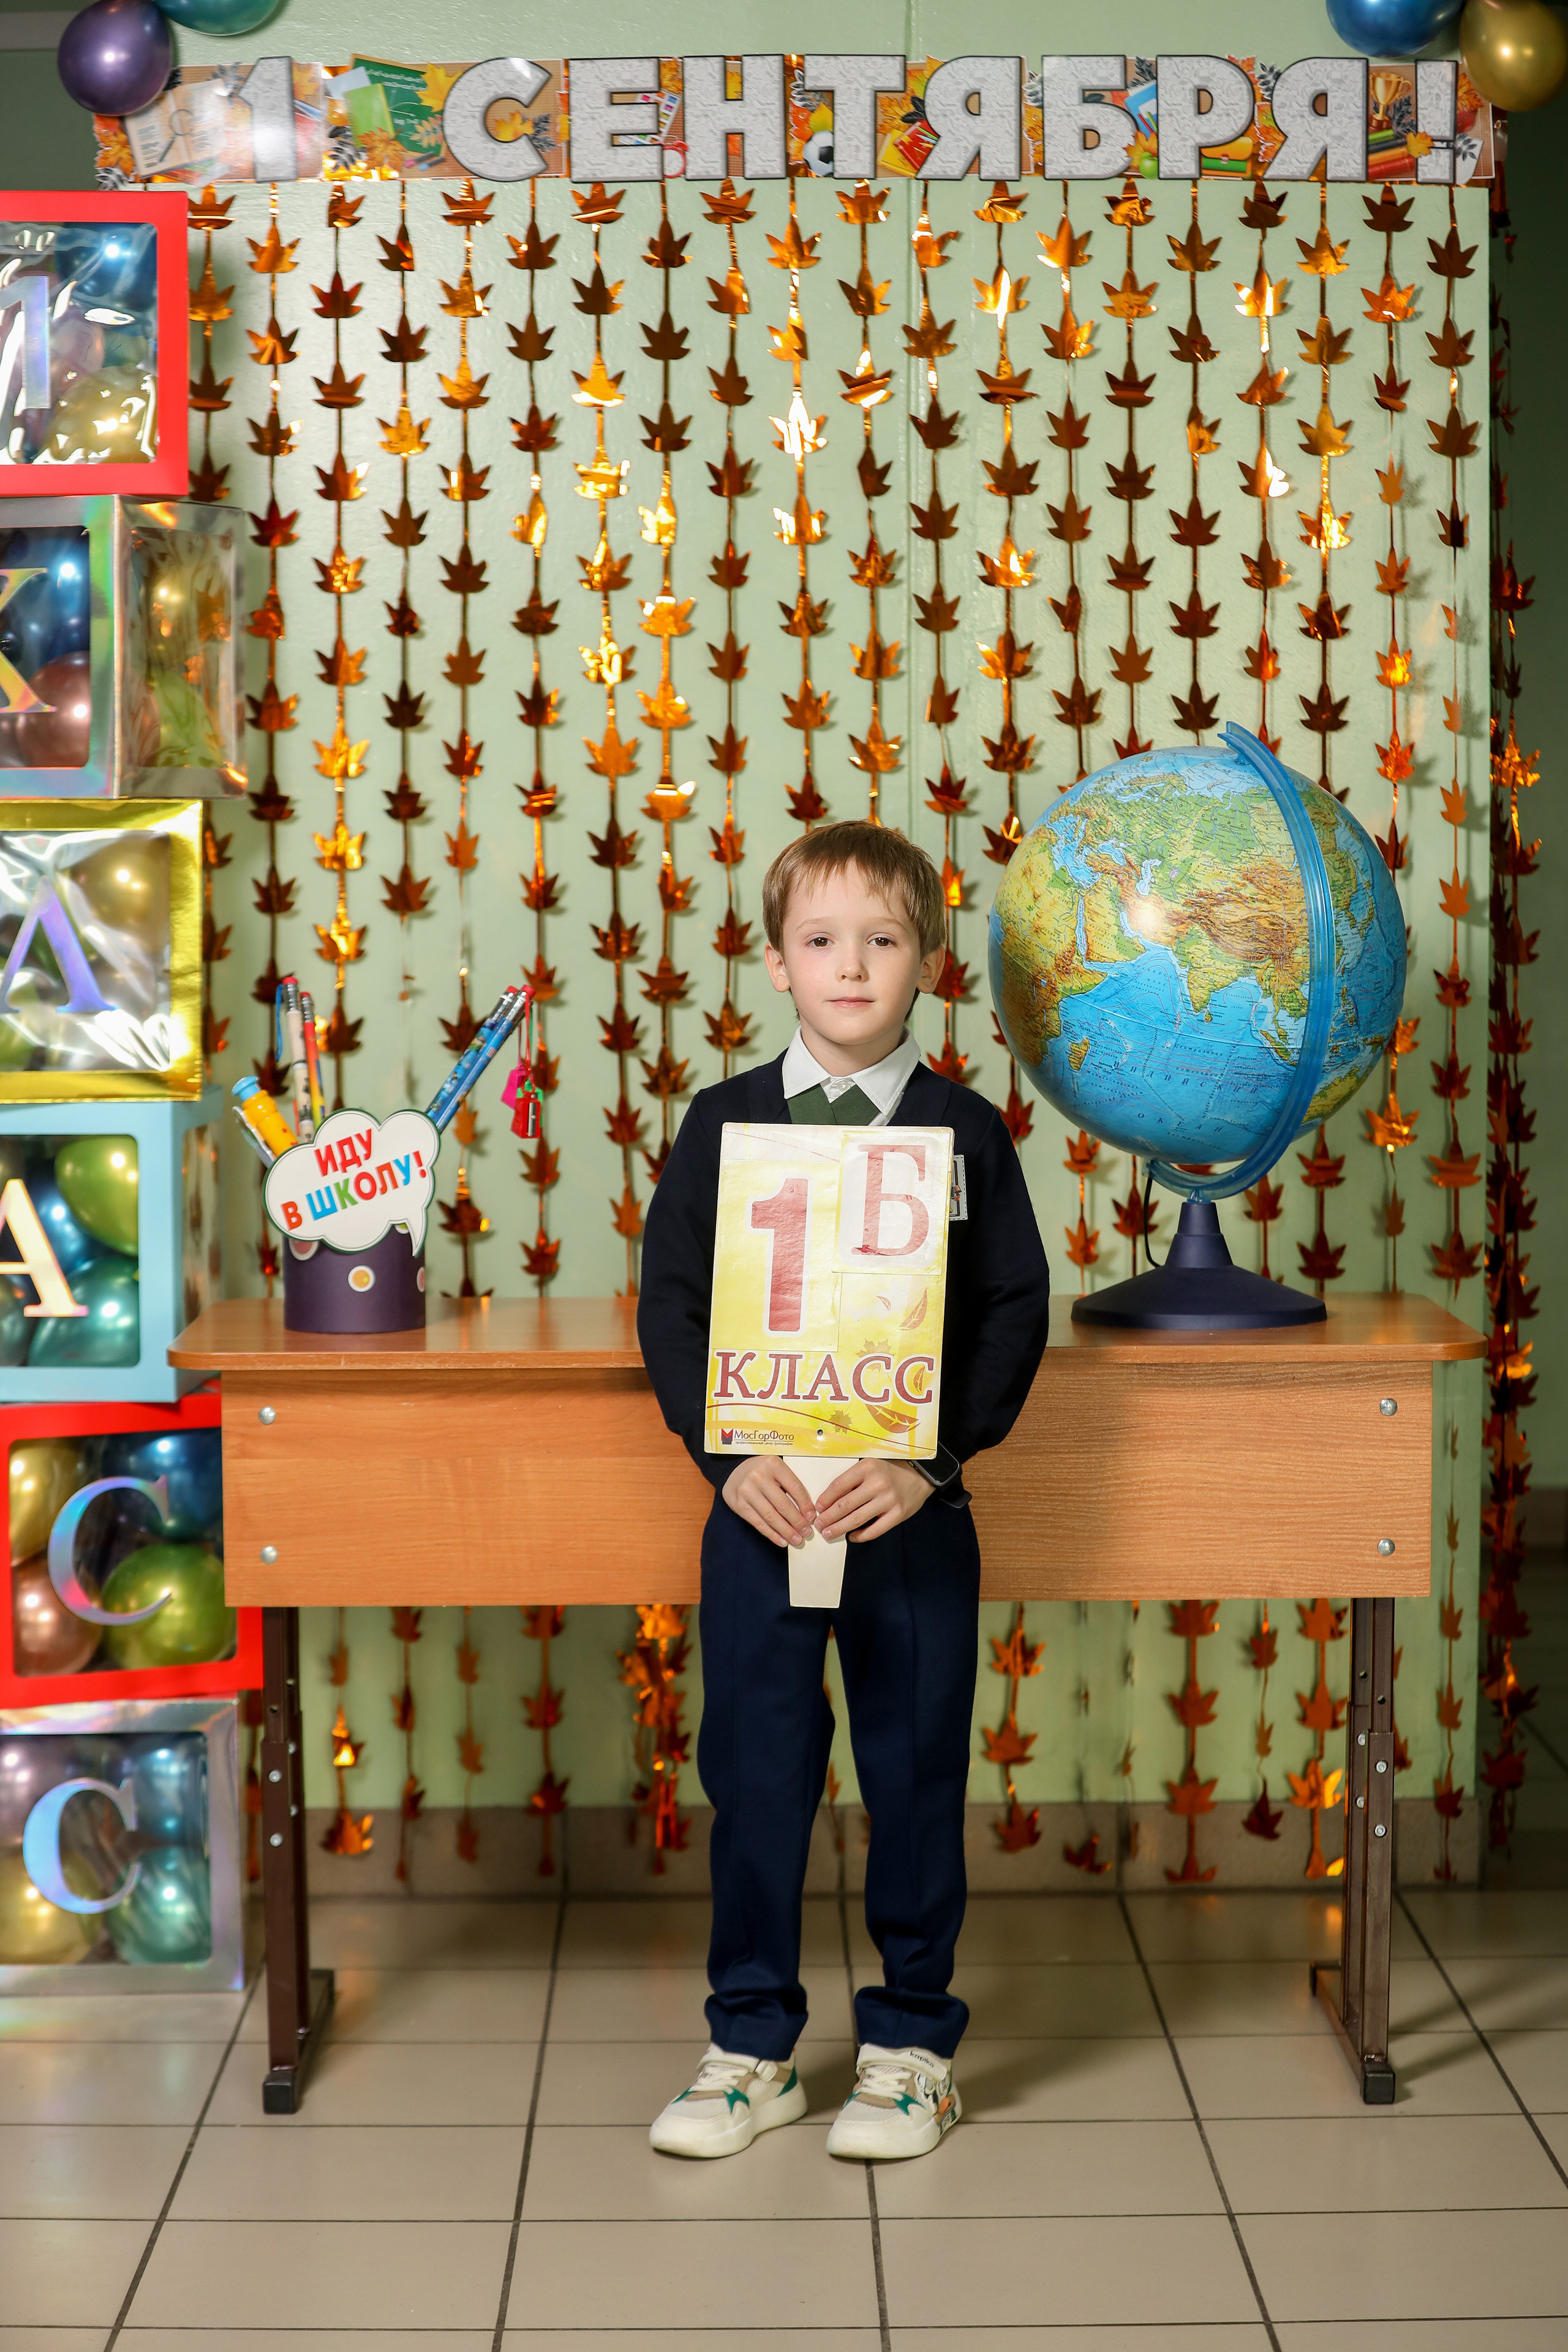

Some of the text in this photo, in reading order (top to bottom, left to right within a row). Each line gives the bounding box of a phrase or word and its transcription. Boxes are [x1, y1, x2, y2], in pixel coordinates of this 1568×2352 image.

[244, 54, 1458, 184] 1 СЕНТЯБРЯ!
[1113, 1061, 1257, 1094] ИНДИЙСКИЙ
[1137, 1112, 1223, 1133] ОКЕАН
[314, 1128, 374, 1177] ИДУ
[280, 1150, 428, 1231] В ШКОЛУ!
[713, 1351, 935, 1404] КЛАСС
[734, 1430, 794, 1442] МосГорФото
[910, 2051, 934, 2068] kapika
